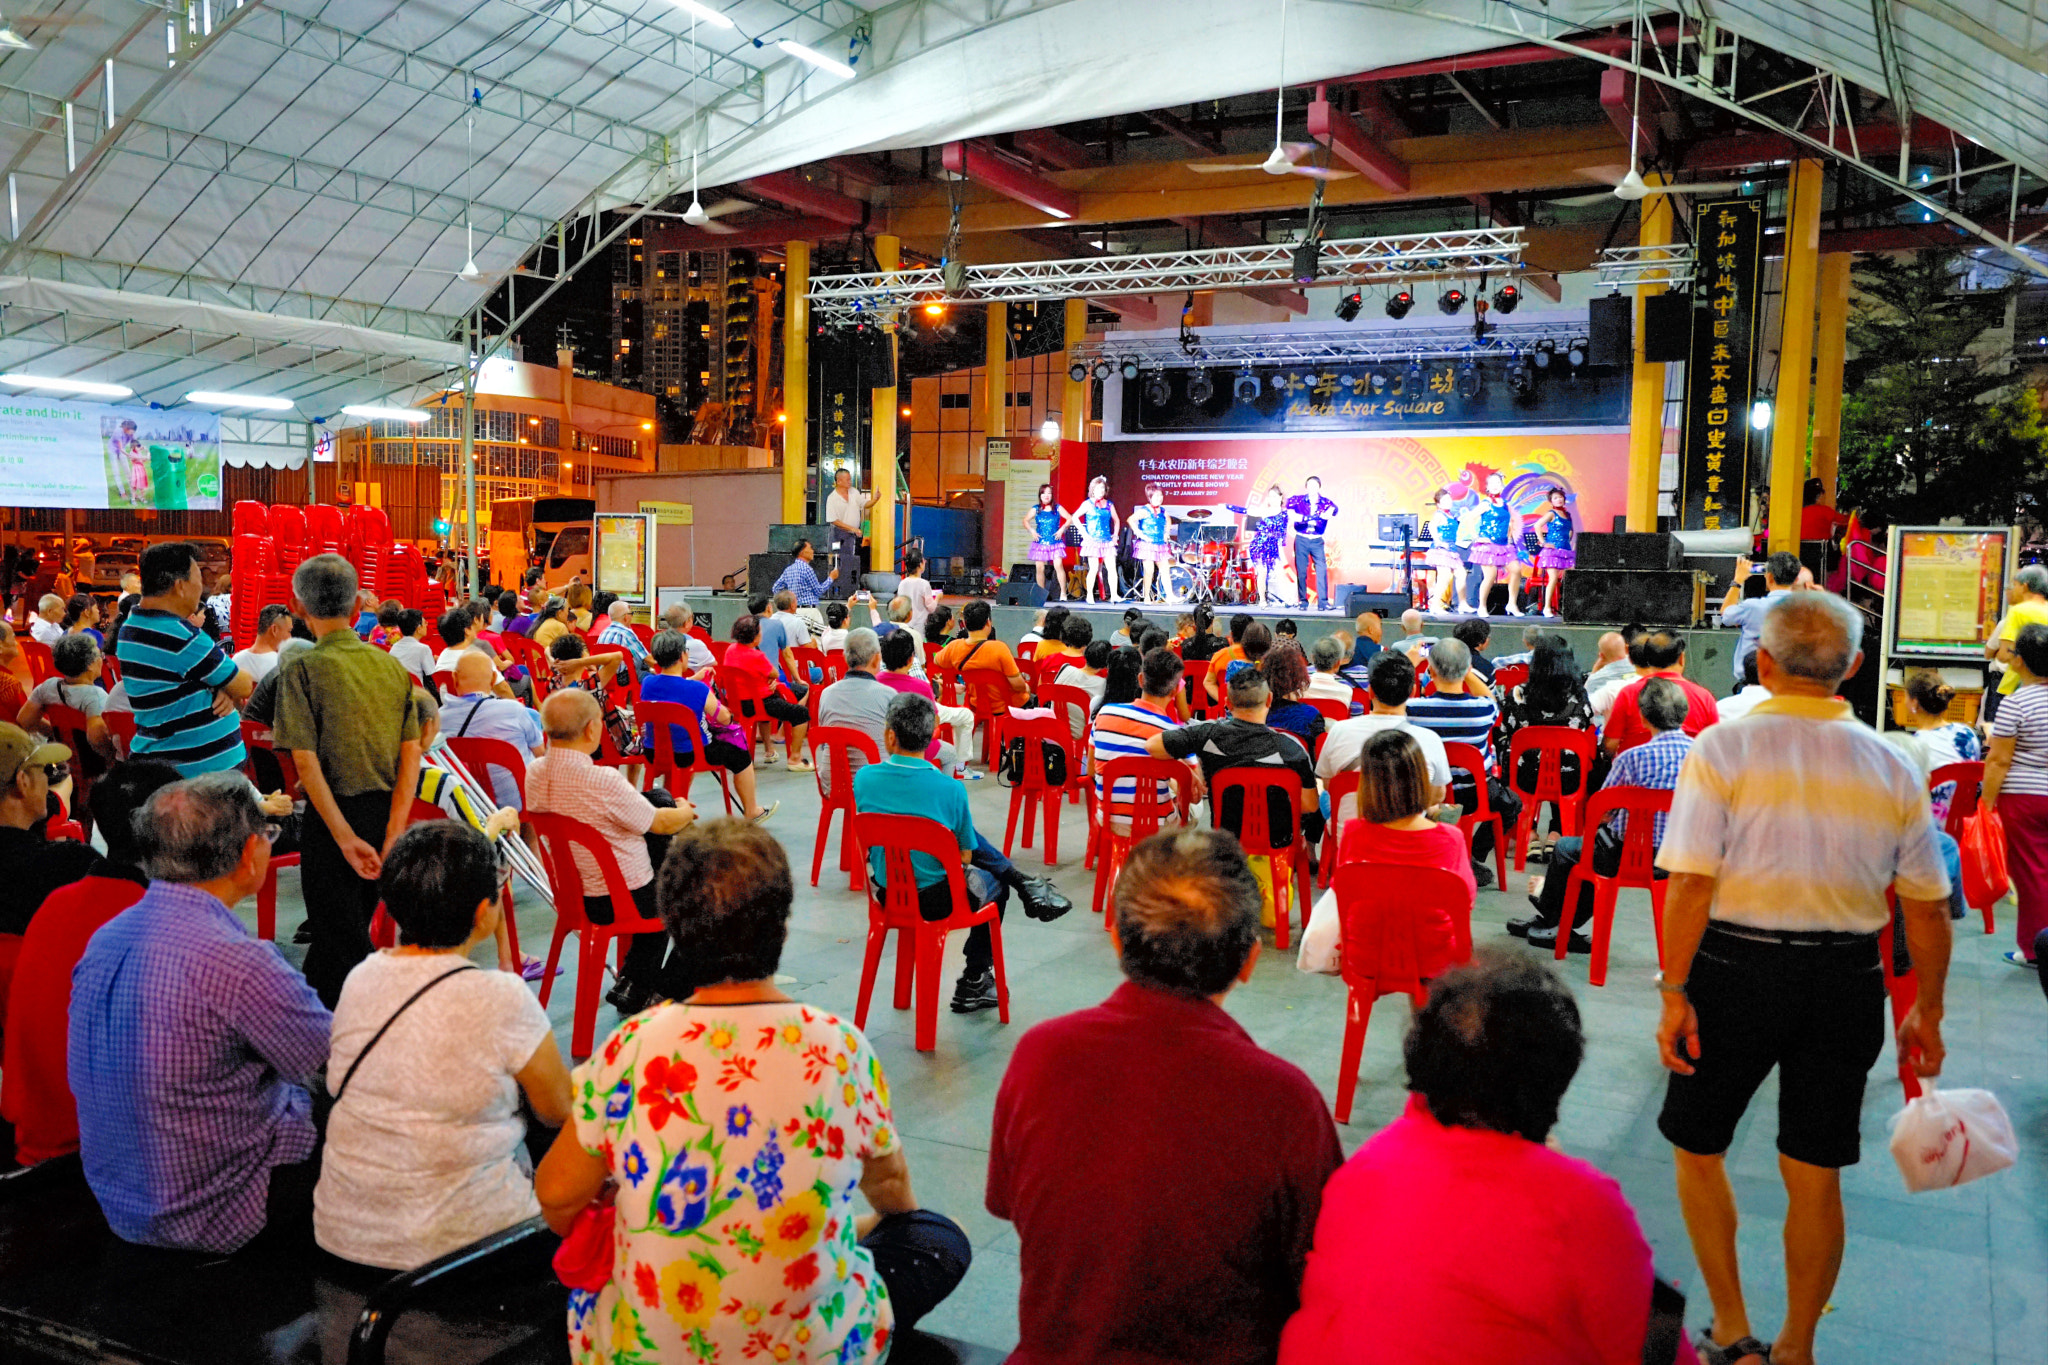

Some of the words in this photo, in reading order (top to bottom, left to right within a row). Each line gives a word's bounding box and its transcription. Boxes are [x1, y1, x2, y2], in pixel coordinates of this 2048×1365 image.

[25, 407, 48, 418] and
[51, 408, 70, 419] bin
[1340, 400, 1381, 417] Ayer
[1382, 400, 1445, 420] Square
